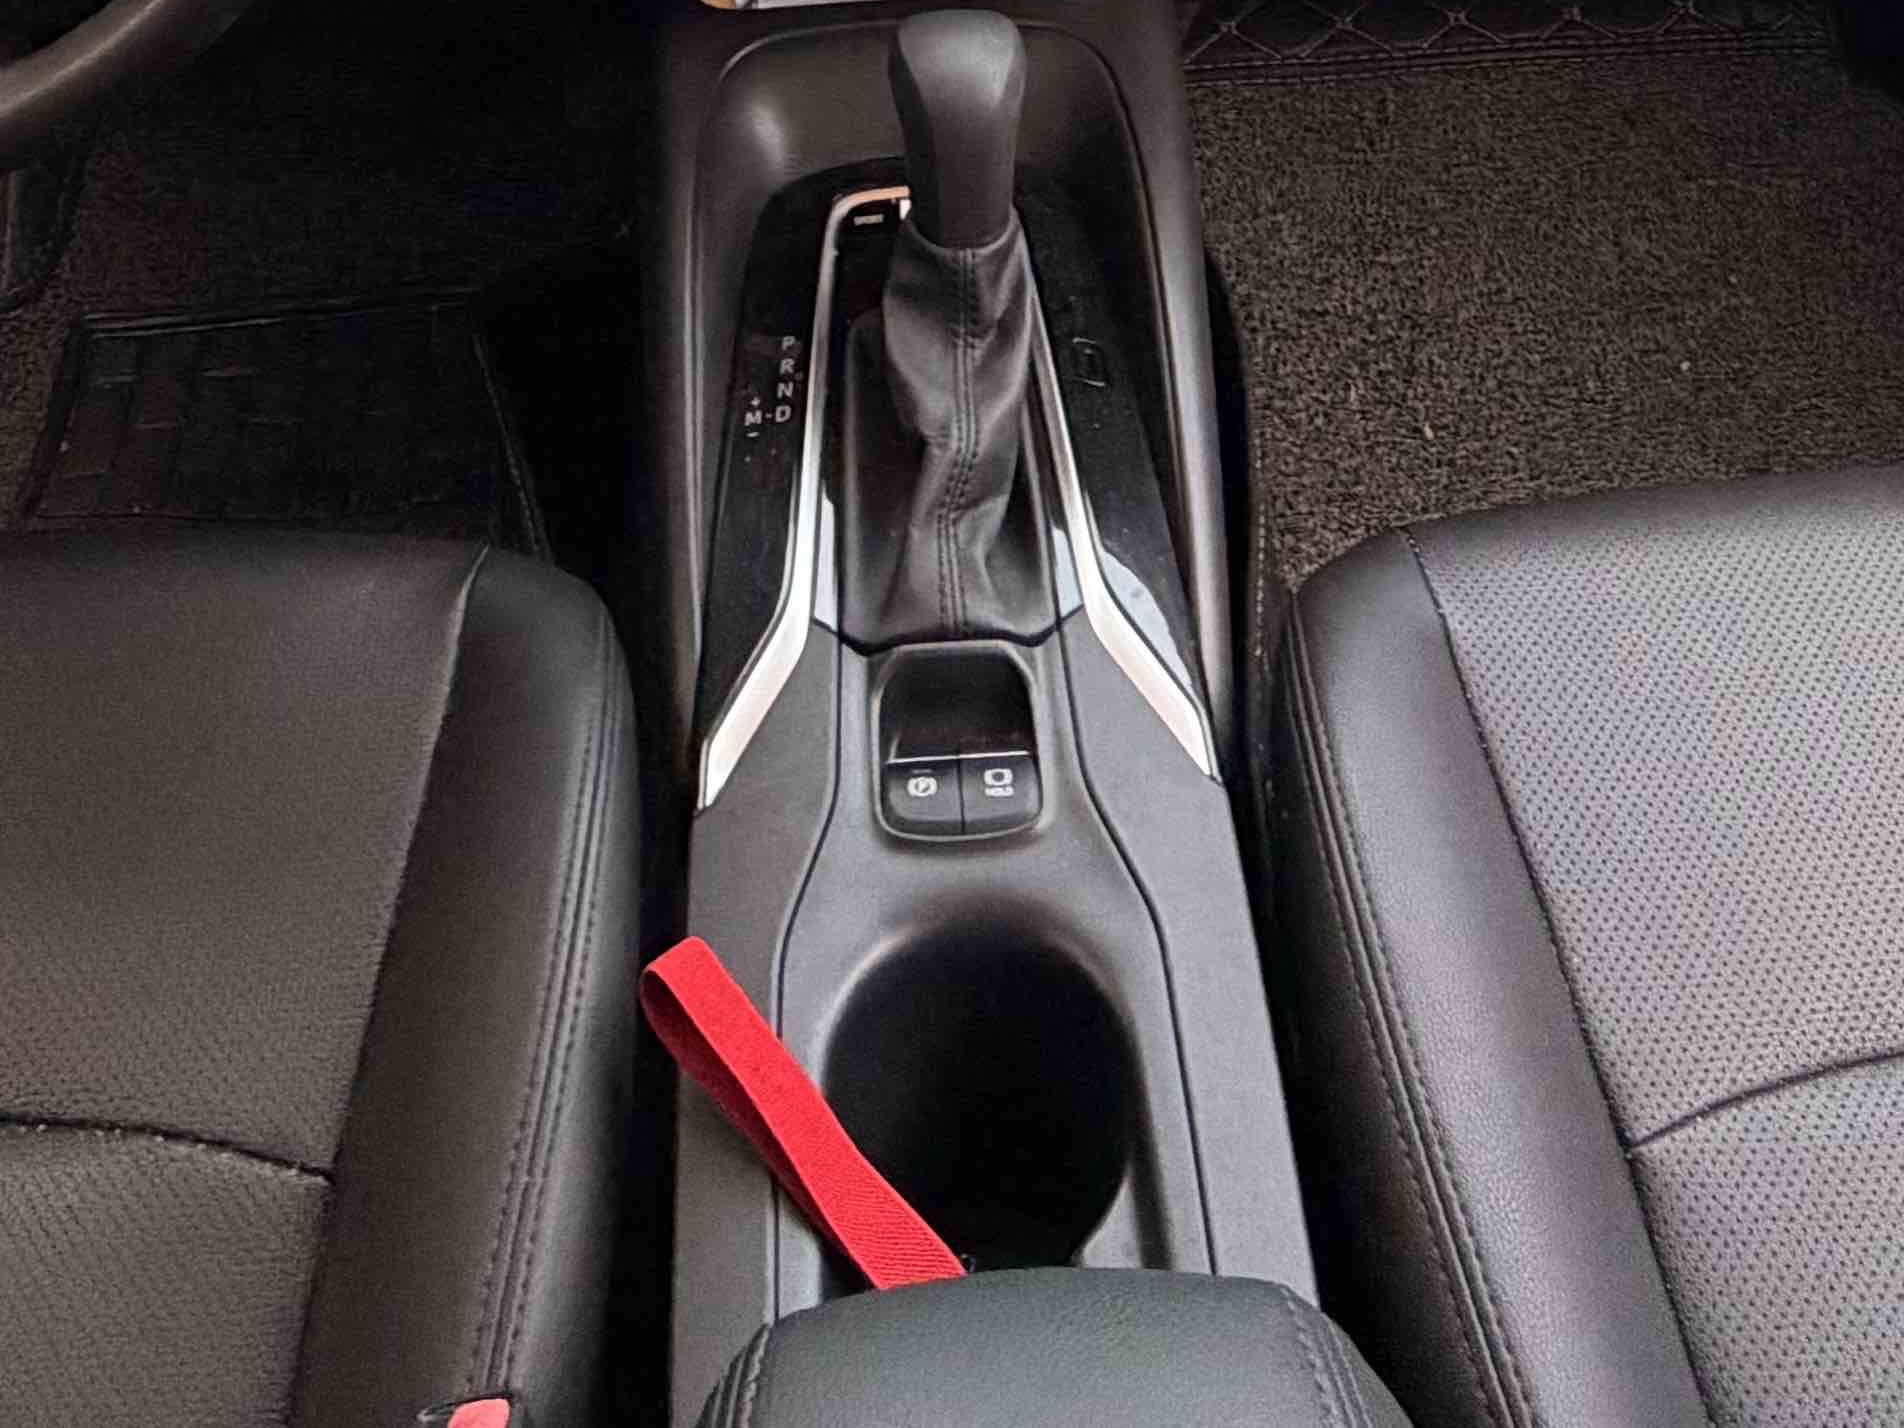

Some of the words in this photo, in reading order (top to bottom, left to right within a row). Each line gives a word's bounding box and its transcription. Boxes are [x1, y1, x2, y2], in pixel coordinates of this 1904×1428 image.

[781, 335, 796, 352] P
[779, 357, 796, 375] R
[777, 381, 794, 400] N
